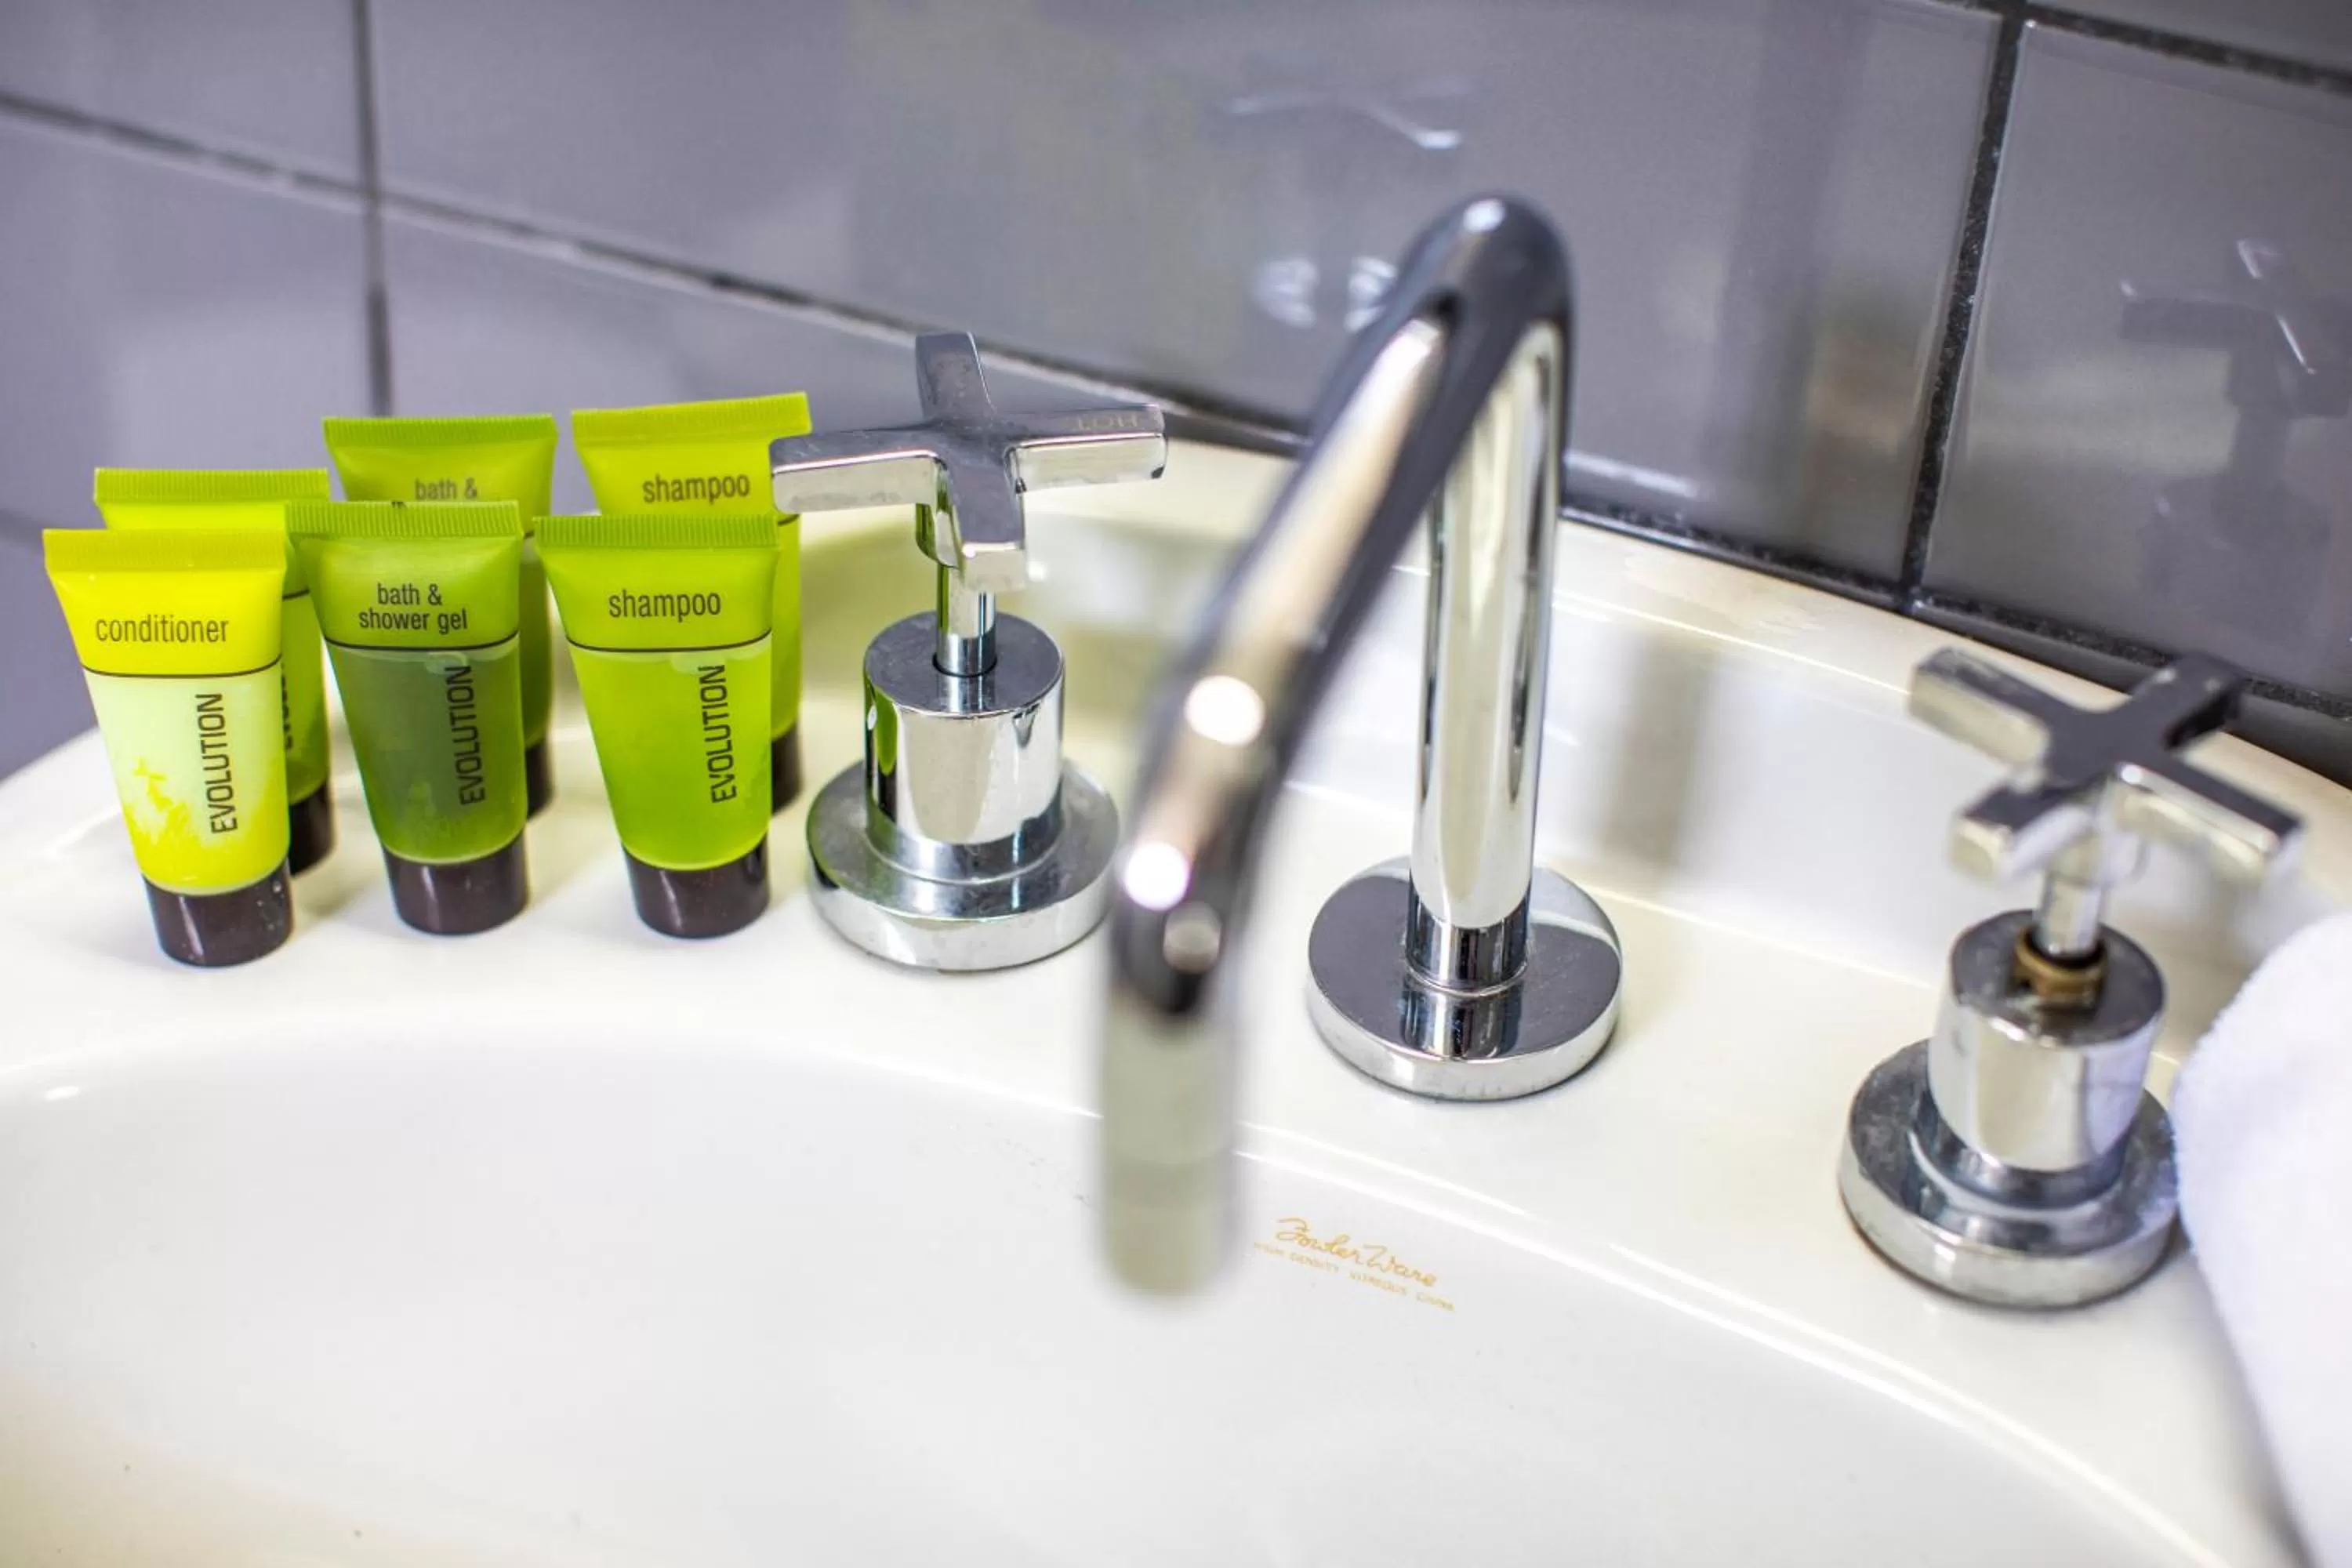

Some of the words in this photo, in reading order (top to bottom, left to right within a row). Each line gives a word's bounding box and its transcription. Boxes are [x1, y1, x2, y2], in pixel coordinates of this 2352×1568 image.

[415, 477, 457, 499] bath
[464, 477, 478, 499] &
[641, 474, 750, 505] shampoo
[377, 583, 420, 605] bath
[427, 583, 443, 606] &
[608, 589, 722, 623] shampoo
[96, 614, 229, 643] conditioner
[358, 608, 430, 630] shower
[437, 608, 468, 634] gel
[444, 664, 486, 806] EVOLUTION
[697, 664, 738, 804] EVOLUTION
[194, 692, 239, 834] EVOLUTION
